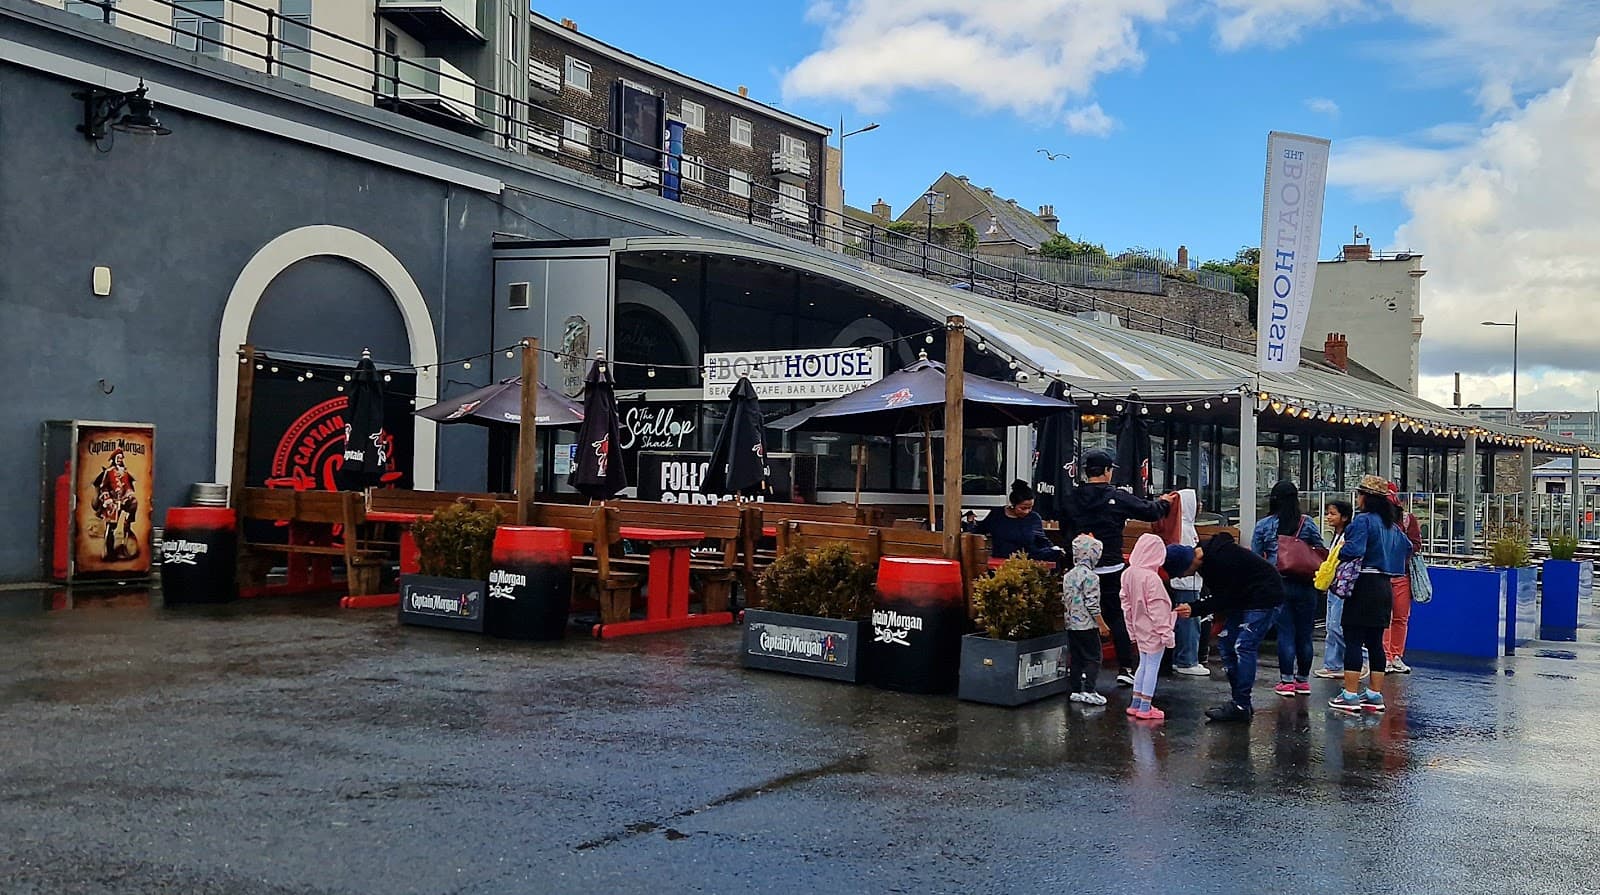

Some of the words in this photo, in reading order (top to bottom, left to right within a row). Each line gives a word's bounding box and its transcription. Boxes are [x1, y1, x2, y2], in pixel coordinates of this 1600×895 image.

[709, 358, 717, 380] THE
[709, 386, 732, 396] SEAF
[787, 385, 806, 394] BAR
[820, 384, 861, 393] TAKEAW
[639, 407, 654, 421] The
[620, 407, 696, 449] Scallop
[88, 439, 116, 456] Captain
[115, 438, 146, 456] Morgan
[294, 415, 345, 465] CAPTAIN
[640, 436, 674, 448] Shack
[176, 540, 208, 554] Morgan
[497, 570, 526, 587] Morgan
[411, 592, 434, 610] Captain
[433, 594, 458, 612] Morgan
[887, 610, 923, 631] Morgan
[760, 632, 790, 653] Captain
[788, 635, 823, 657] Morgan
